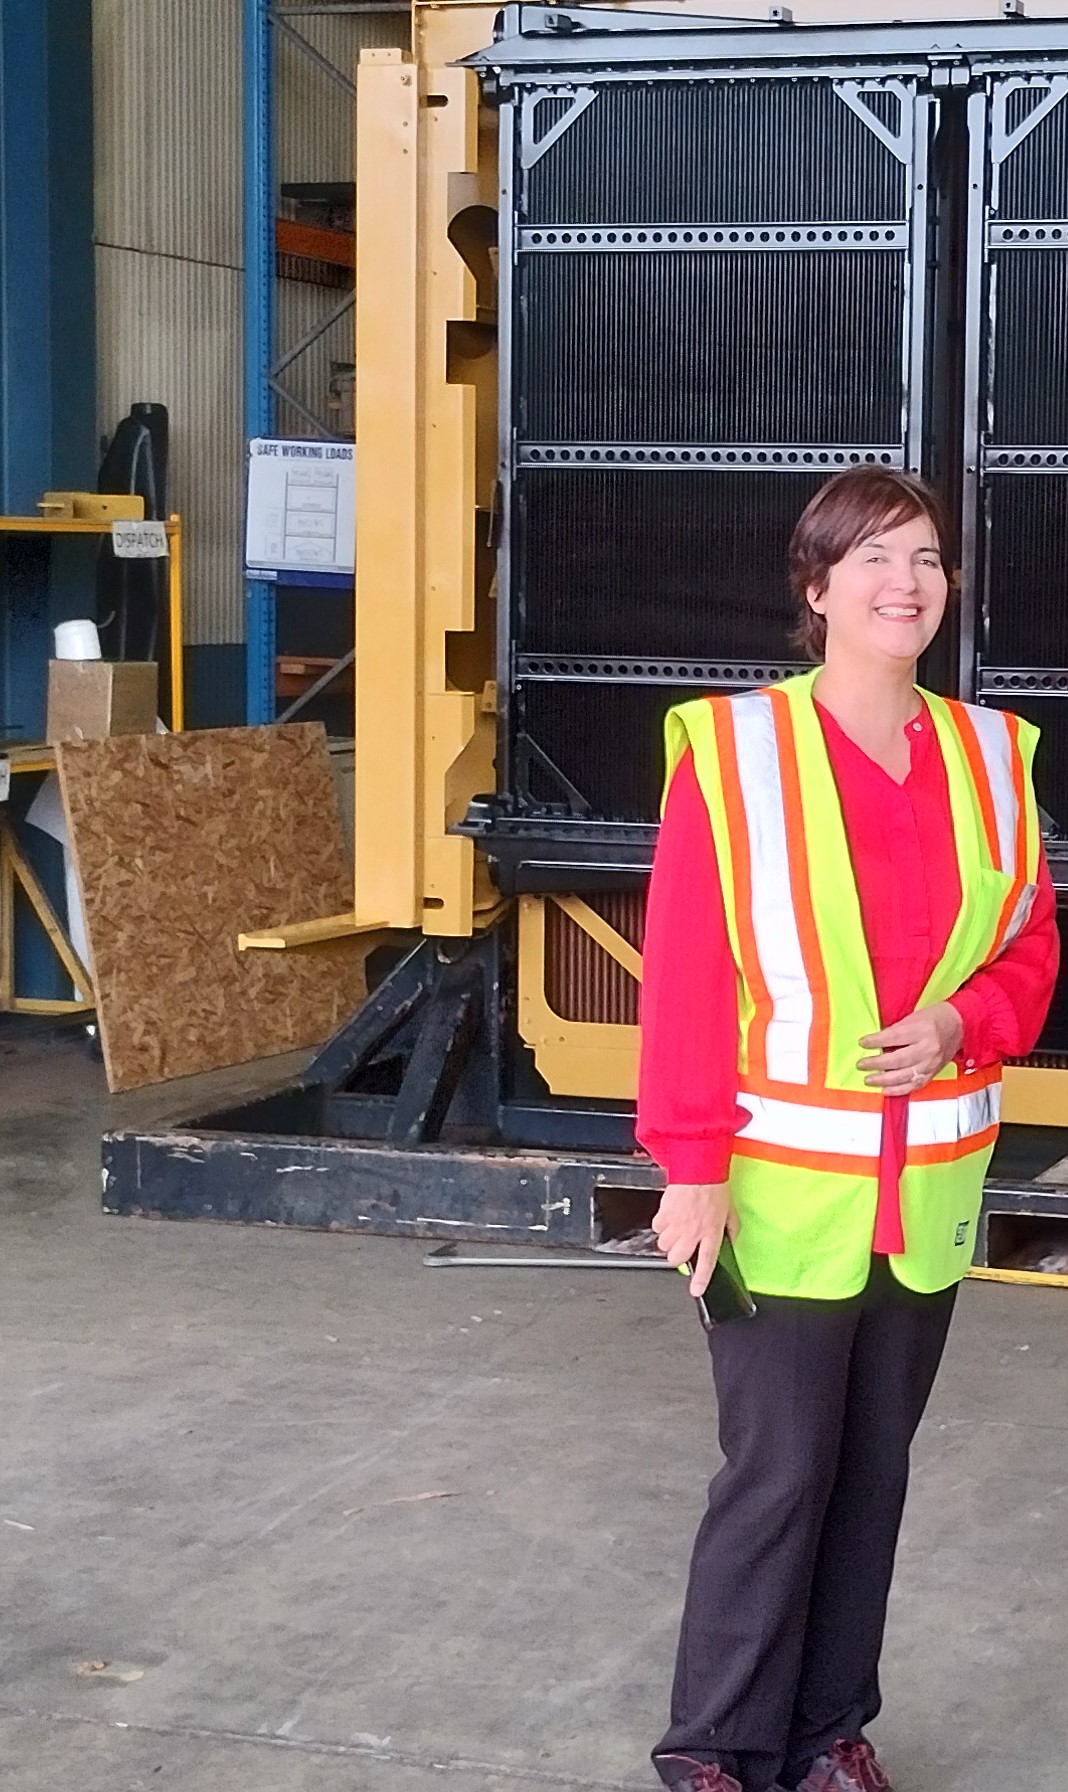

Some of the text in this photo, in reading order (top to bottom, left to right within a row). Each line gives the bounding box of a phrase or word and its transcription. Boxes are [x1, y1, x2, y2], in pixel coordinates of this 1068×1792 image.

[256, 443, 354, 461] SAFE WORKING LOADS
[115, 532, 164, 548] DISPATCH
